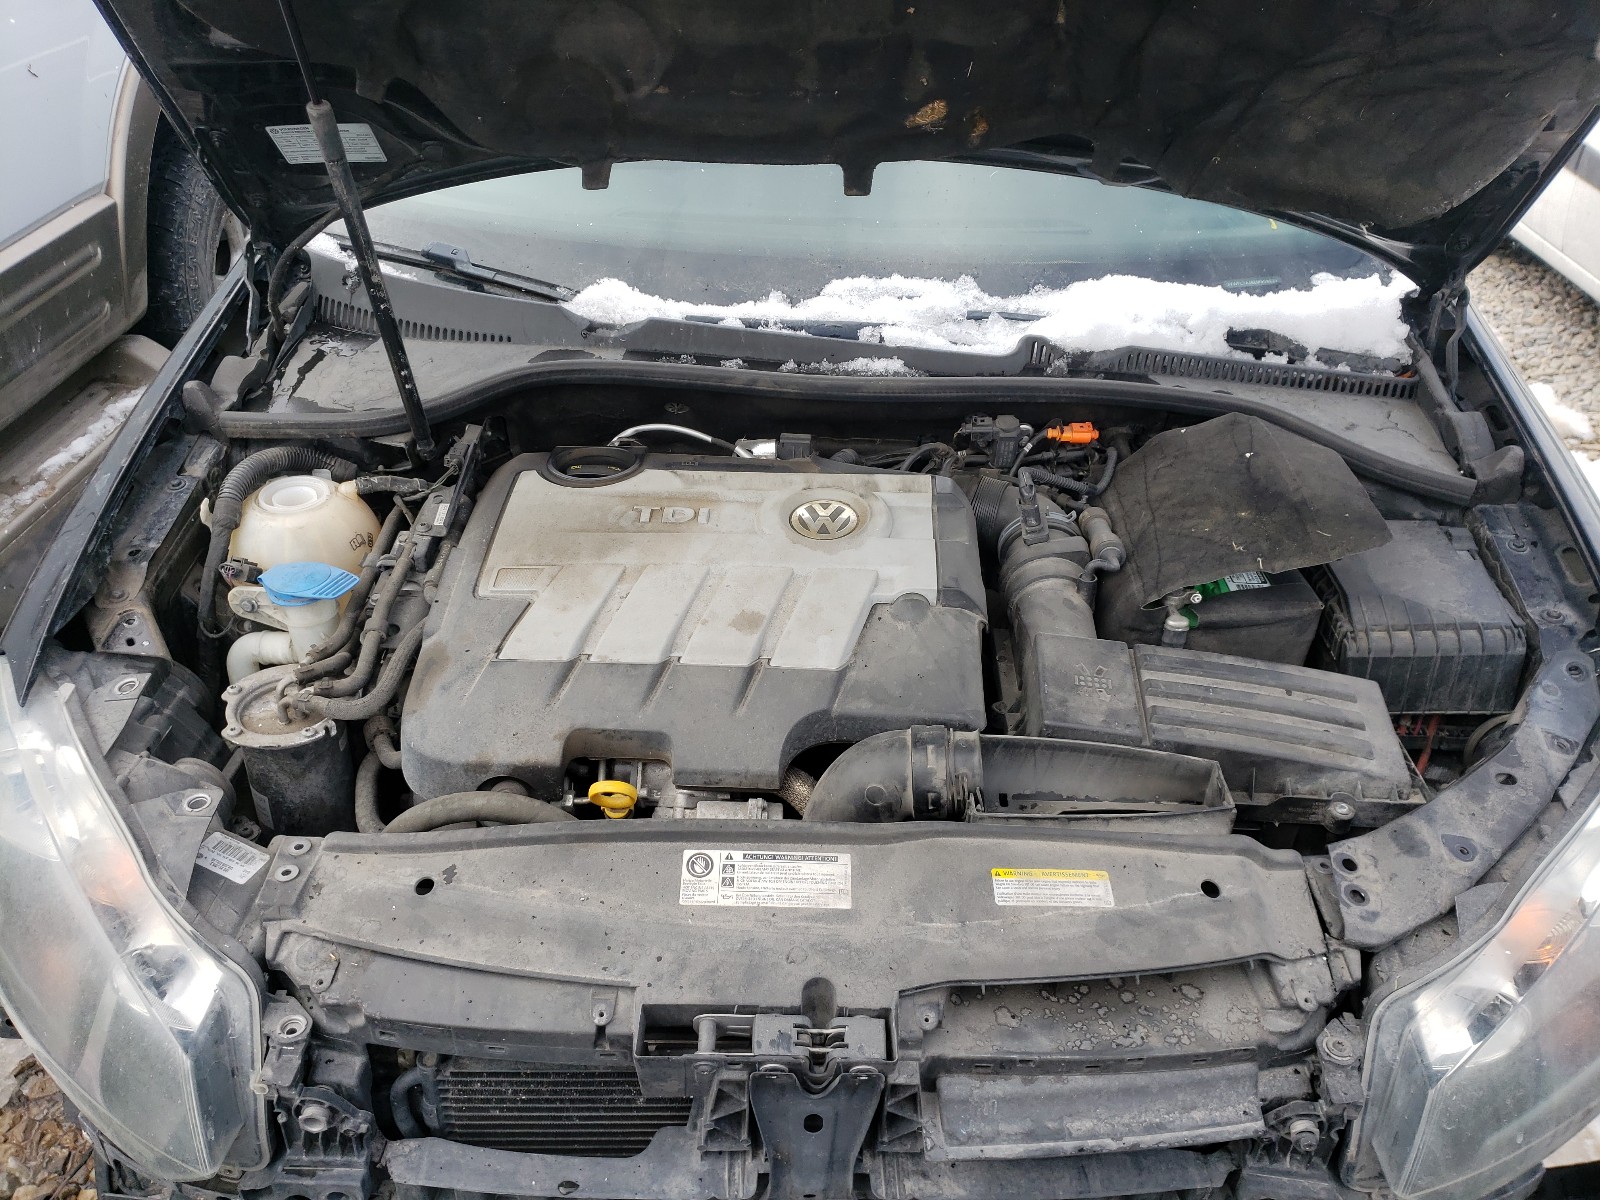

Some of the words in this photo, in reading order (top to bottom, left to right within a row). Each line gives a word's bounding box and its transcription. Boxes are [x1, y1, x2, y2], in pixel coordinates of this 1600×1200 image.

[632, 505, 711, 524] TDI
[744, 853, 774, 861] ACHTUNG!
[775, 854, 804, 862] WARNING!
[804, 855, 838, 863] ATTENTION!
